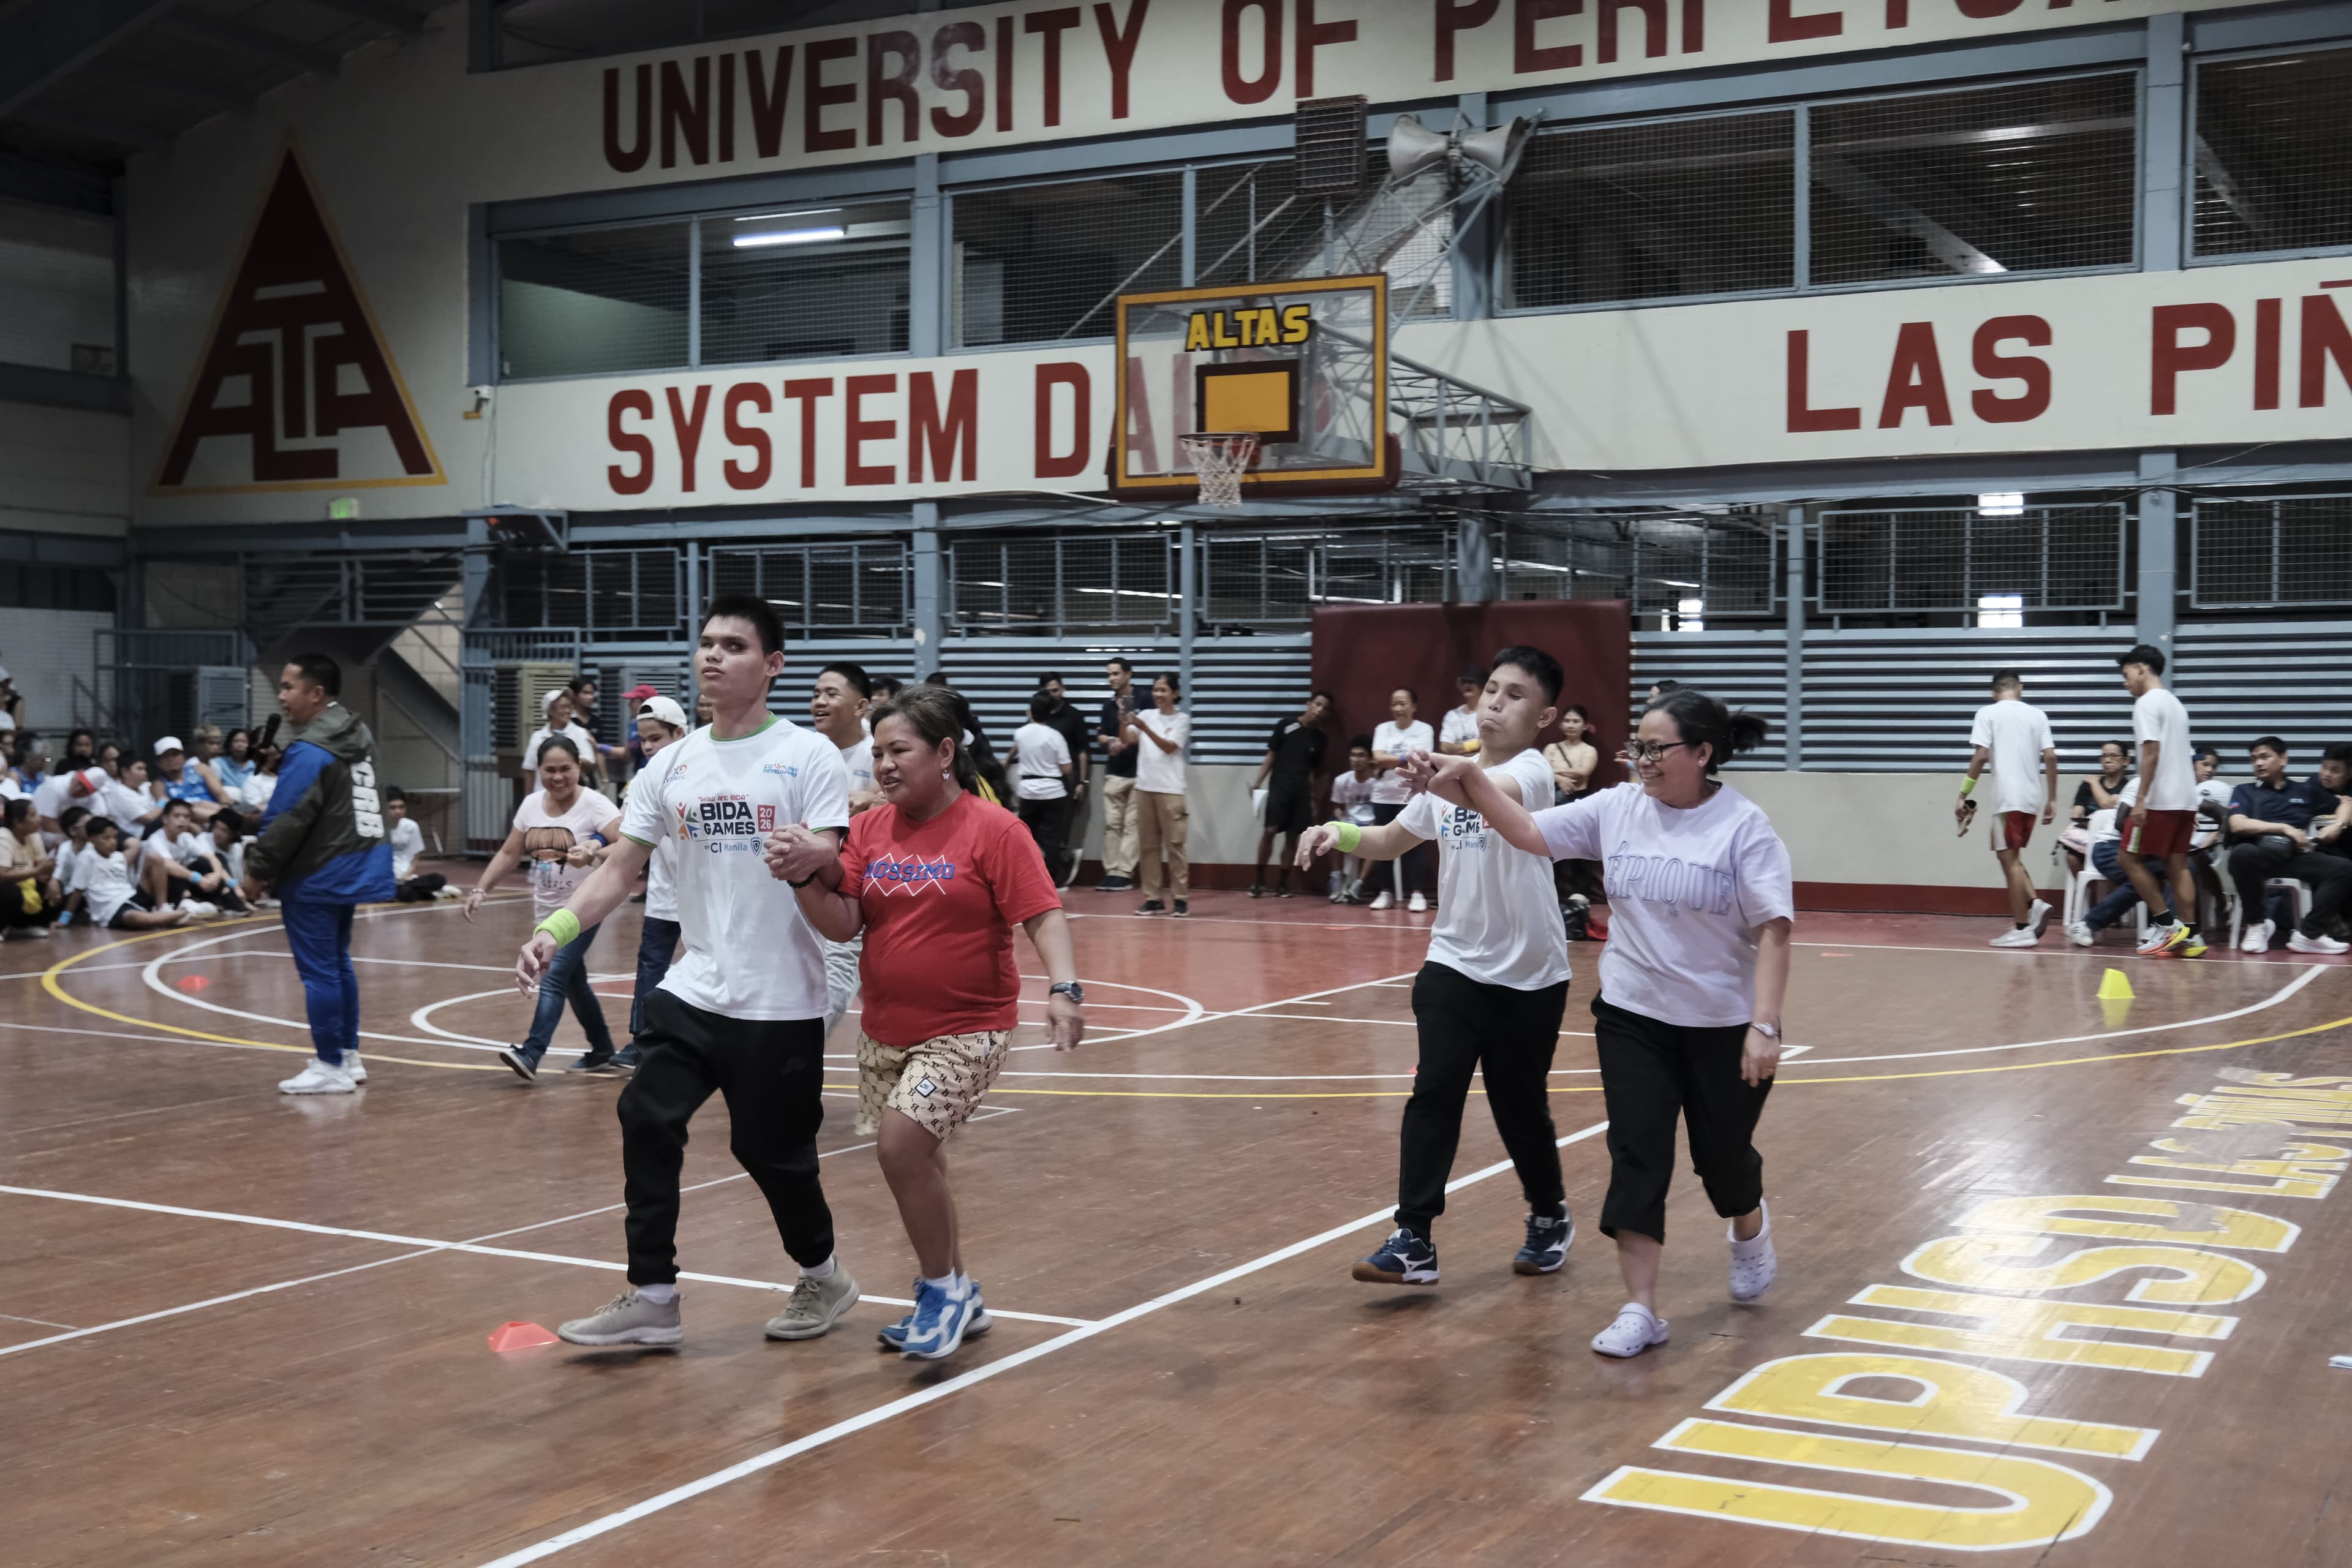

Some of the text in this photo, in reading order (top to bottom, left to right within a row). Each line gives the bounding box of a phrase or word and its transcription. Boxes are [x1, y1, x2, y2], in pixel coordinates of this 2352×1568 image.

[603, 0, 1150, 174] UNIVERSITY
[1185, 303, 1311, 352] ALTAS
[607, 368, 979, 495] SYSTEM
[1787, 314, 2052, 433] LAS
[699, 801, 753, 821] BIDA
[760, 807, 772, 818] 20
[704, 821, 756, 835] GAMES
[760, 818, 772, 830] 26
[724, 843, 748, 851] Manila
[862, 861, 955, 883] MOSSIMO
[1578, 1194, 2302, 1551] UPHSD
